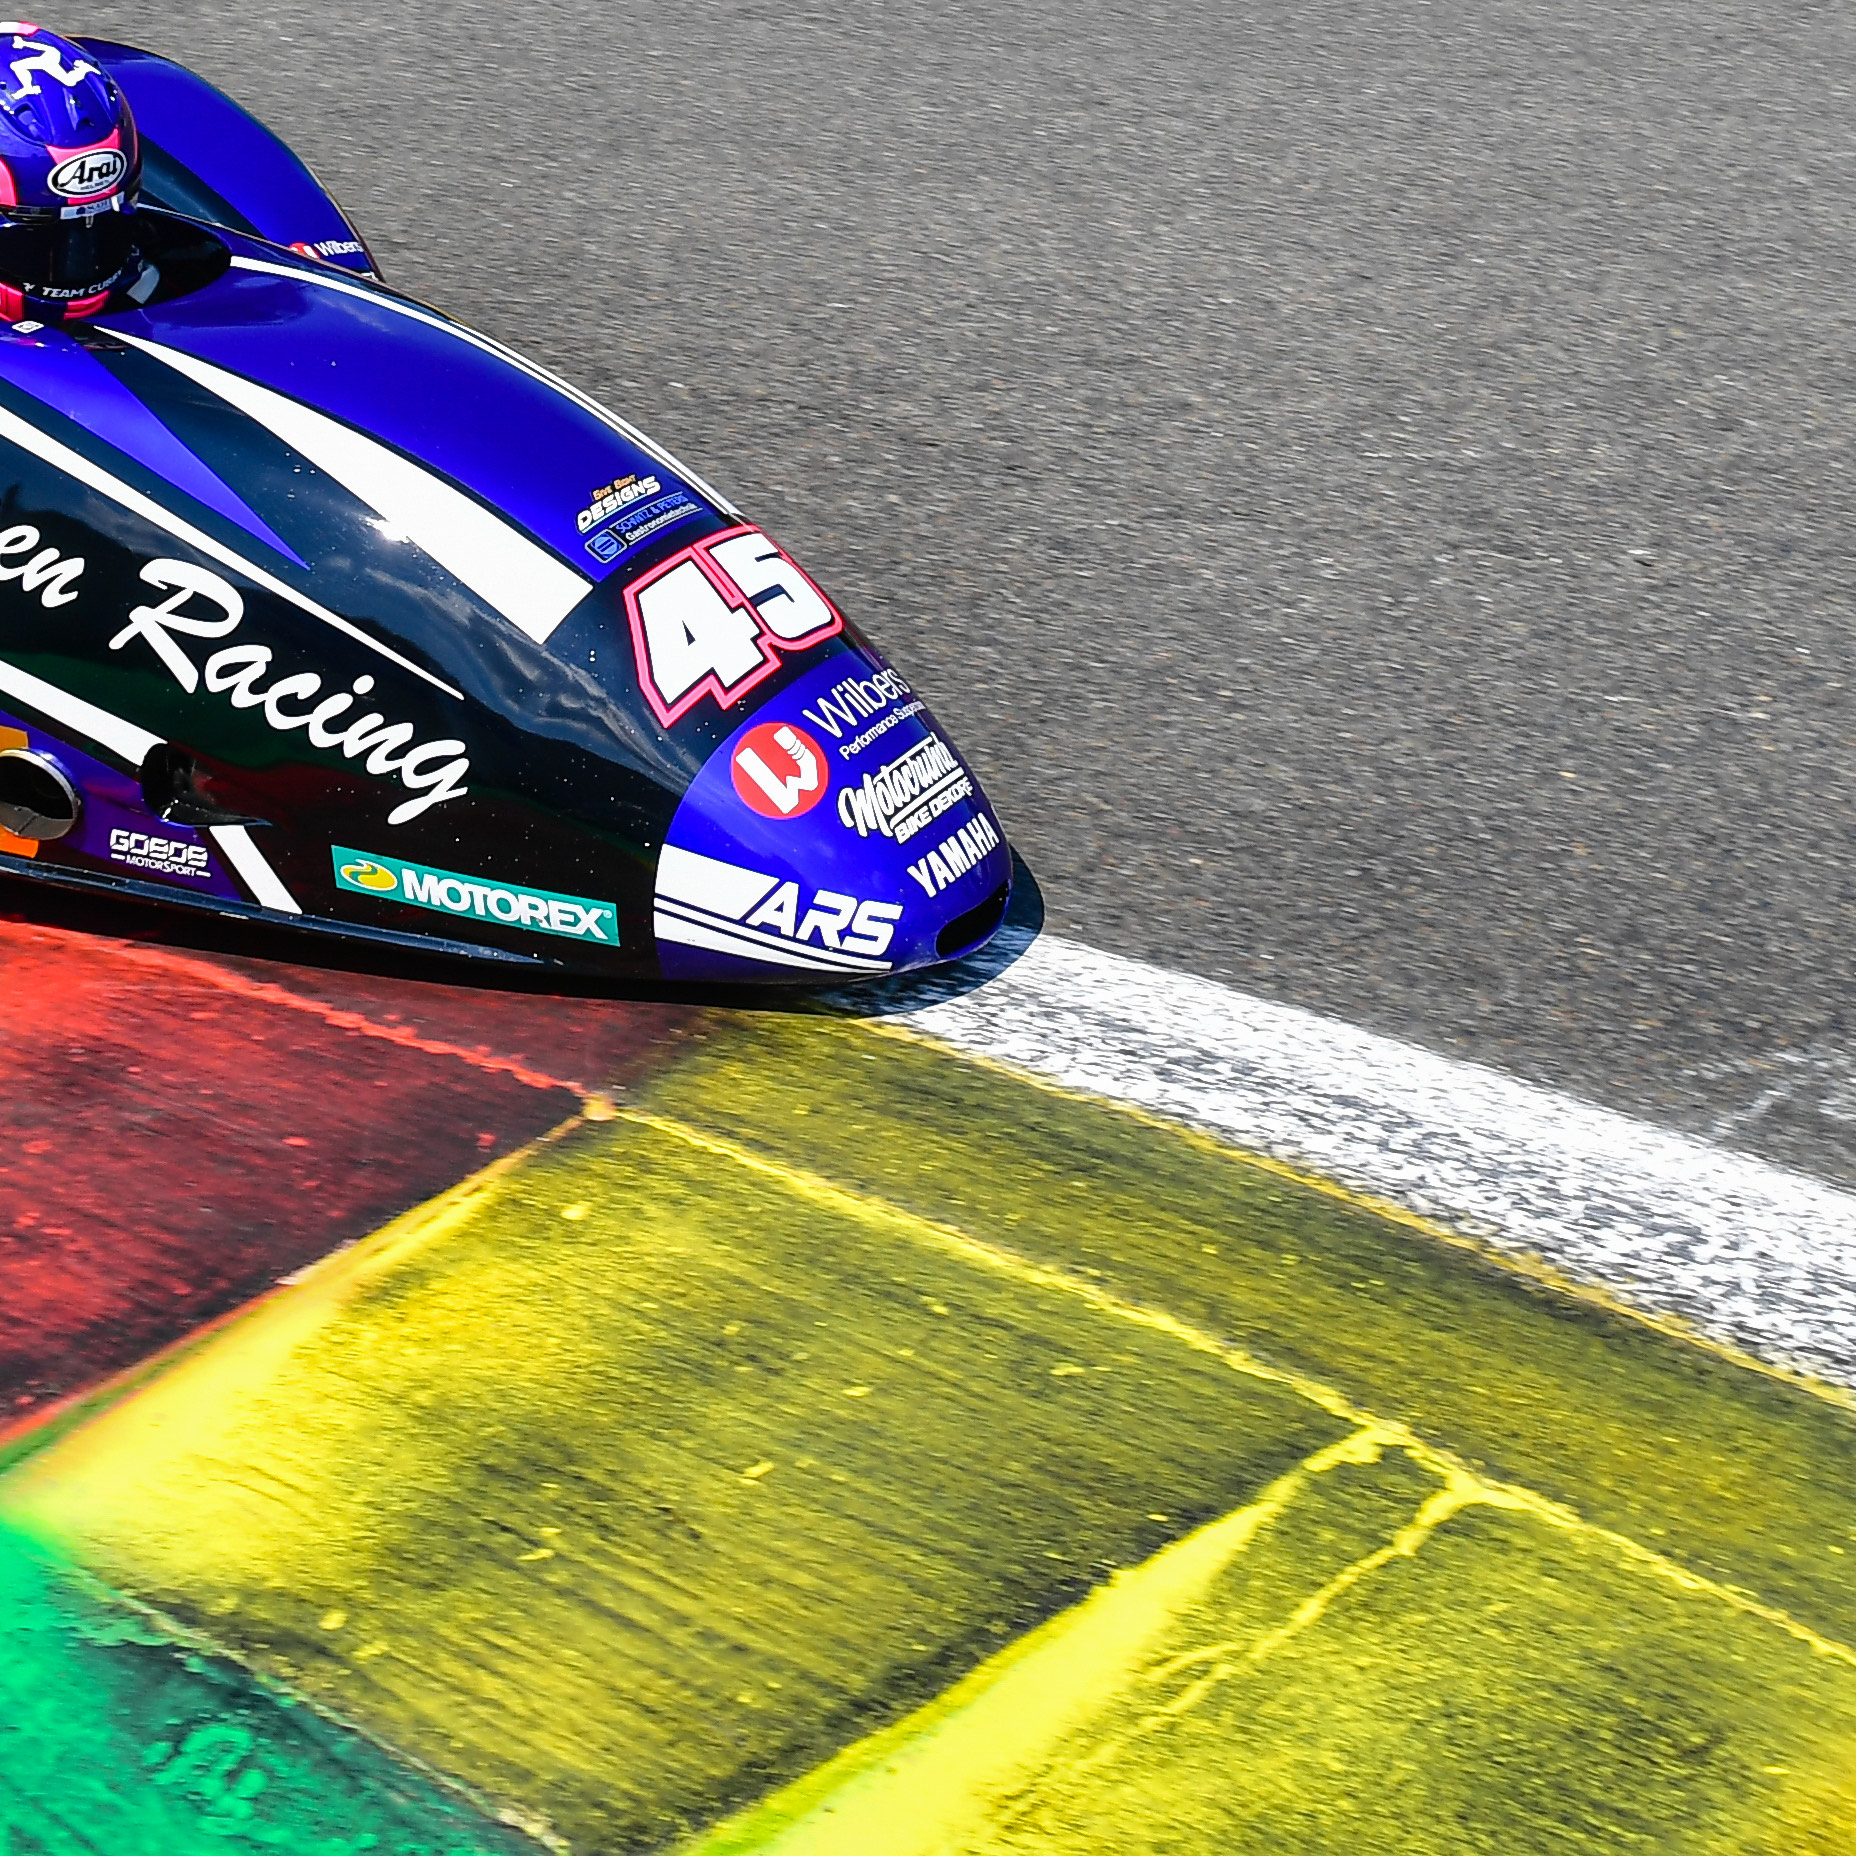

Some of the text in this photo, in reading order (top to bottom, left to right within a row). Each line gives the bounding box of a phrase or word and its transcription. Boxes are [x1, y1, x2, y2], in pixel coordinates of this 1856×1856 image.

[56, 155, 119, 190] Arai
[313, 240, 365, 256] Wilbers
[41, 285, 86, 298] TEAM
[577, 475, 661, 532] DESIGNS
[631, 528, 838, 712] 45
[109, 556, 469, 825] Racing
[802, 667, 912, 739] Wilbers
[838, 714, 899, 761] Performance
[895, 808, 931, 845] BIKE
[906, 812, 1000, 898] YAMAHA
[125, 854, 197, 877] MOTORSPORT
[401, 868, 609, 940] MOTOREX
[745, 880, 904, 957] ARS
